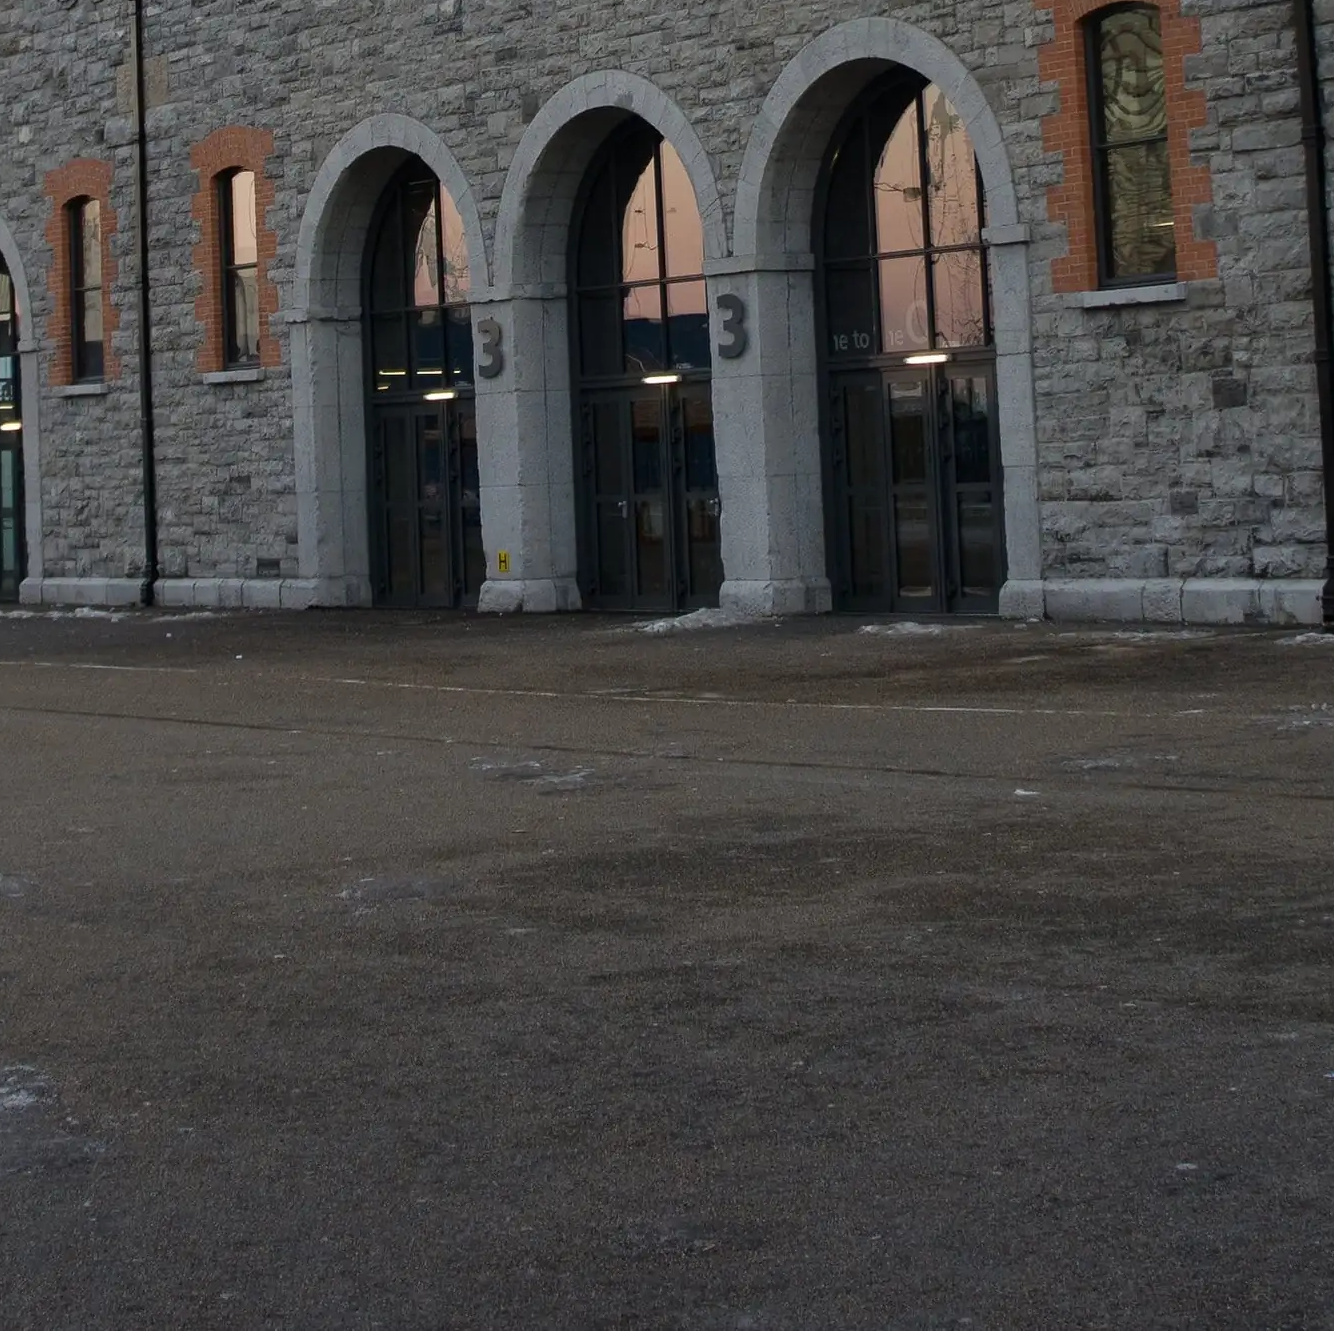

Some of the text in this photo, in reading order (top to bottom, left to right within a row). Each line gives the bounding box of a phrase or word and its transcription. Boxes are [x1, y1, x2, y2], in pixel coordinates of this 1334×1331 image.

[717, 293, 746, 359] 3
[852, 330, 870, 349] to
[477, 320, 503, 379] 3
[498, 553, 507, 569] H
